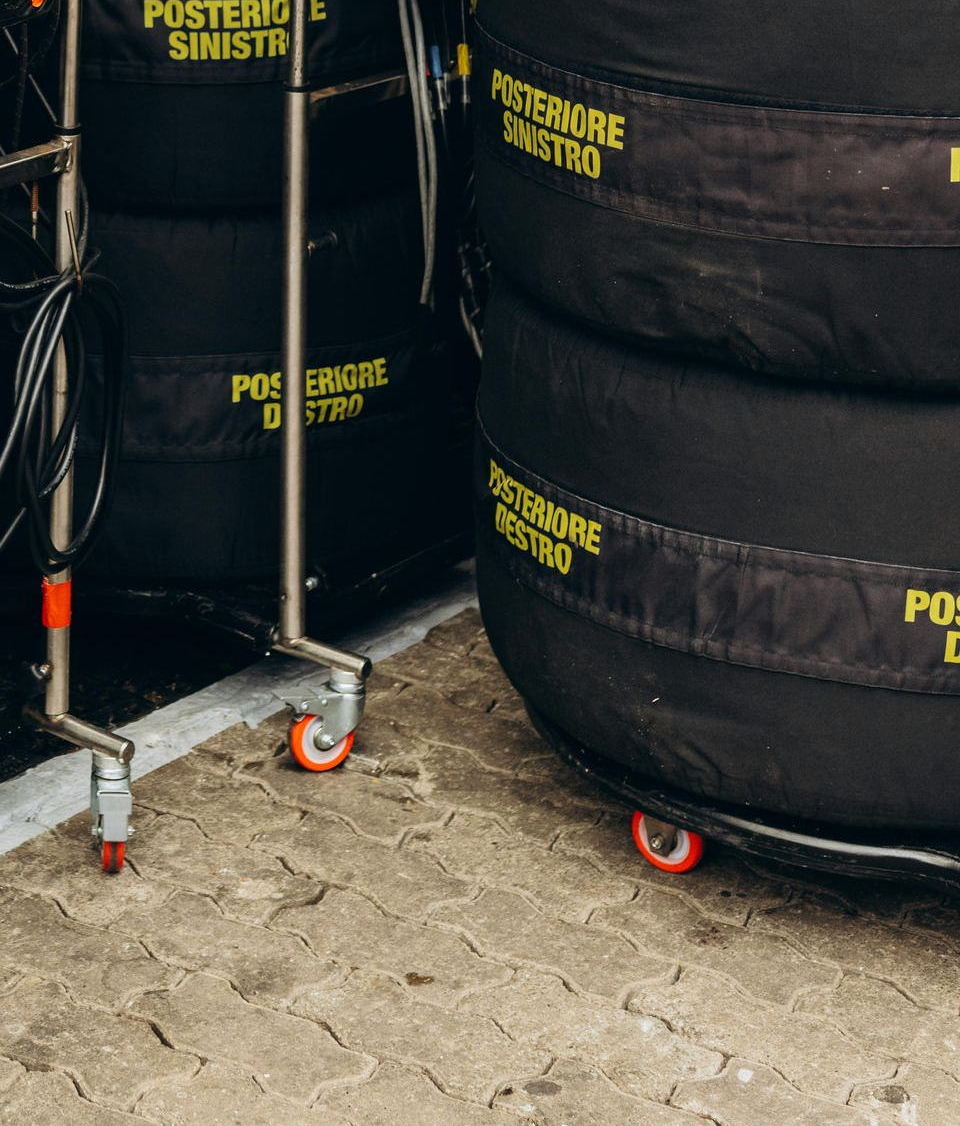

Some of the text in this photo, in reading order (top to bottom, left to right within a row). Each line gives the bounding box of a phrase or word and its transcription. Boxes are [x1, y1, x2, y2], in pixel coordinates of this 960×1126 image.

[168, 28, 289, 61] SINISTR
[491, 68, 626, 151] POSTERIORE
[503, 110, 601, 179] SINISTRO
[232, 357, 389, 403] POSERIORE
[263, 393, 364, 430] DSTRO
[488, 458, 602, 556] POSTERIORE
[495, 502, 573, 575] DESTRO
